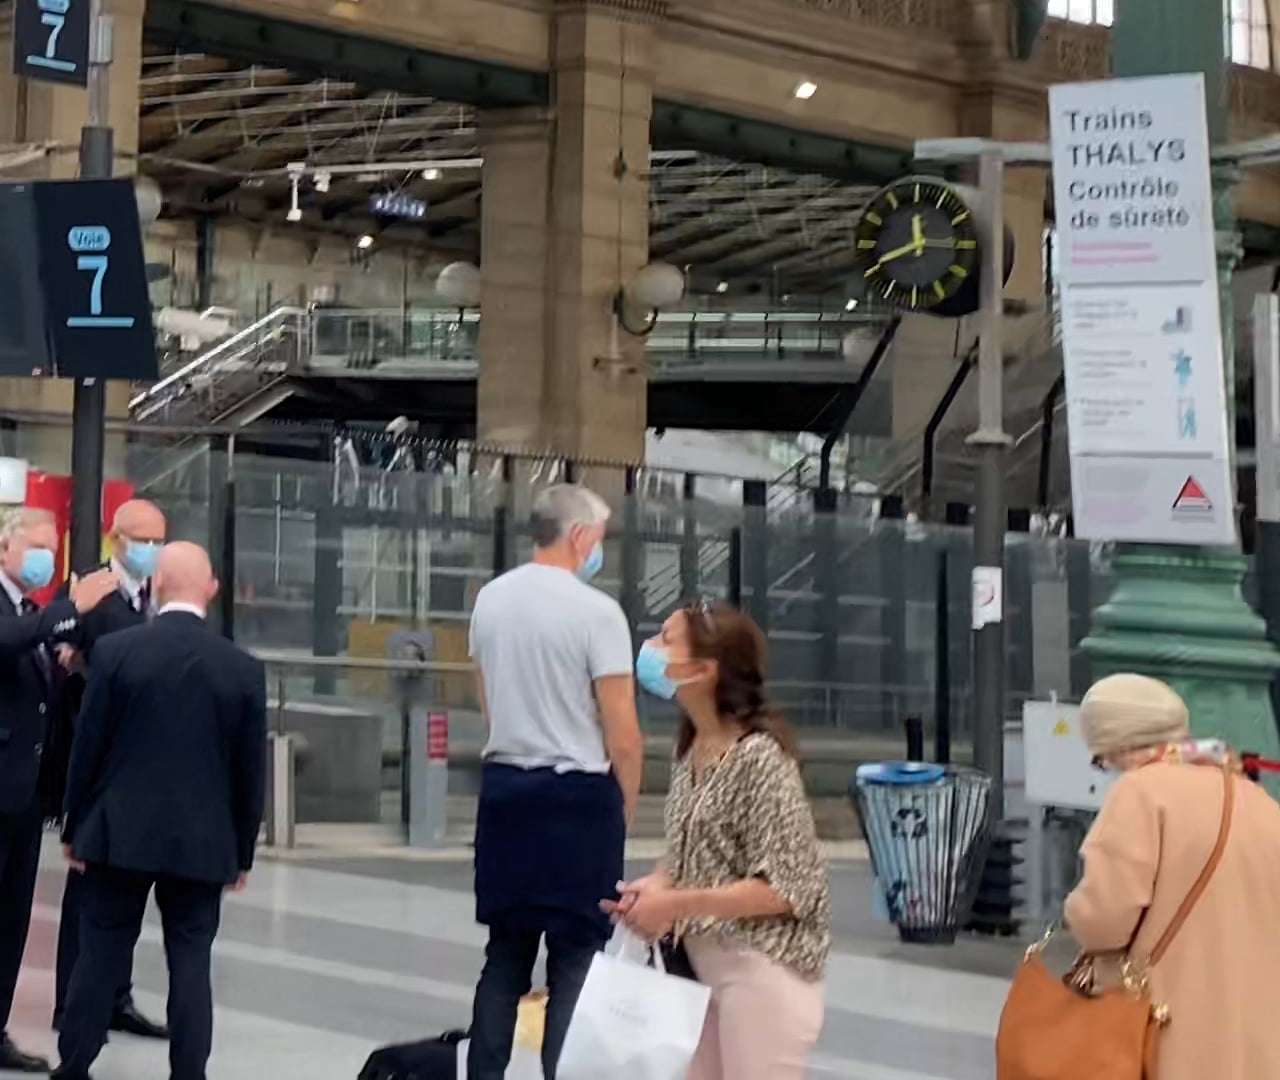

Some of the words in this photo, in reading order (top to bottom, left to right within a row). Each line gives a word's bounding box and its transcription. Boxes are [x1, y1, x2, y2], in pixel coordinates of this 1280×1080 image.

[41, 12, 65, 58] 7
[1063, 106, 1153, 132] Trains
[1066, 138, 1186, 168] THALYS
[1069, 176, 1180, 201] Contrôle
[1071, 209, 1100, 229] de
[77, 255, 109, 316] 7
